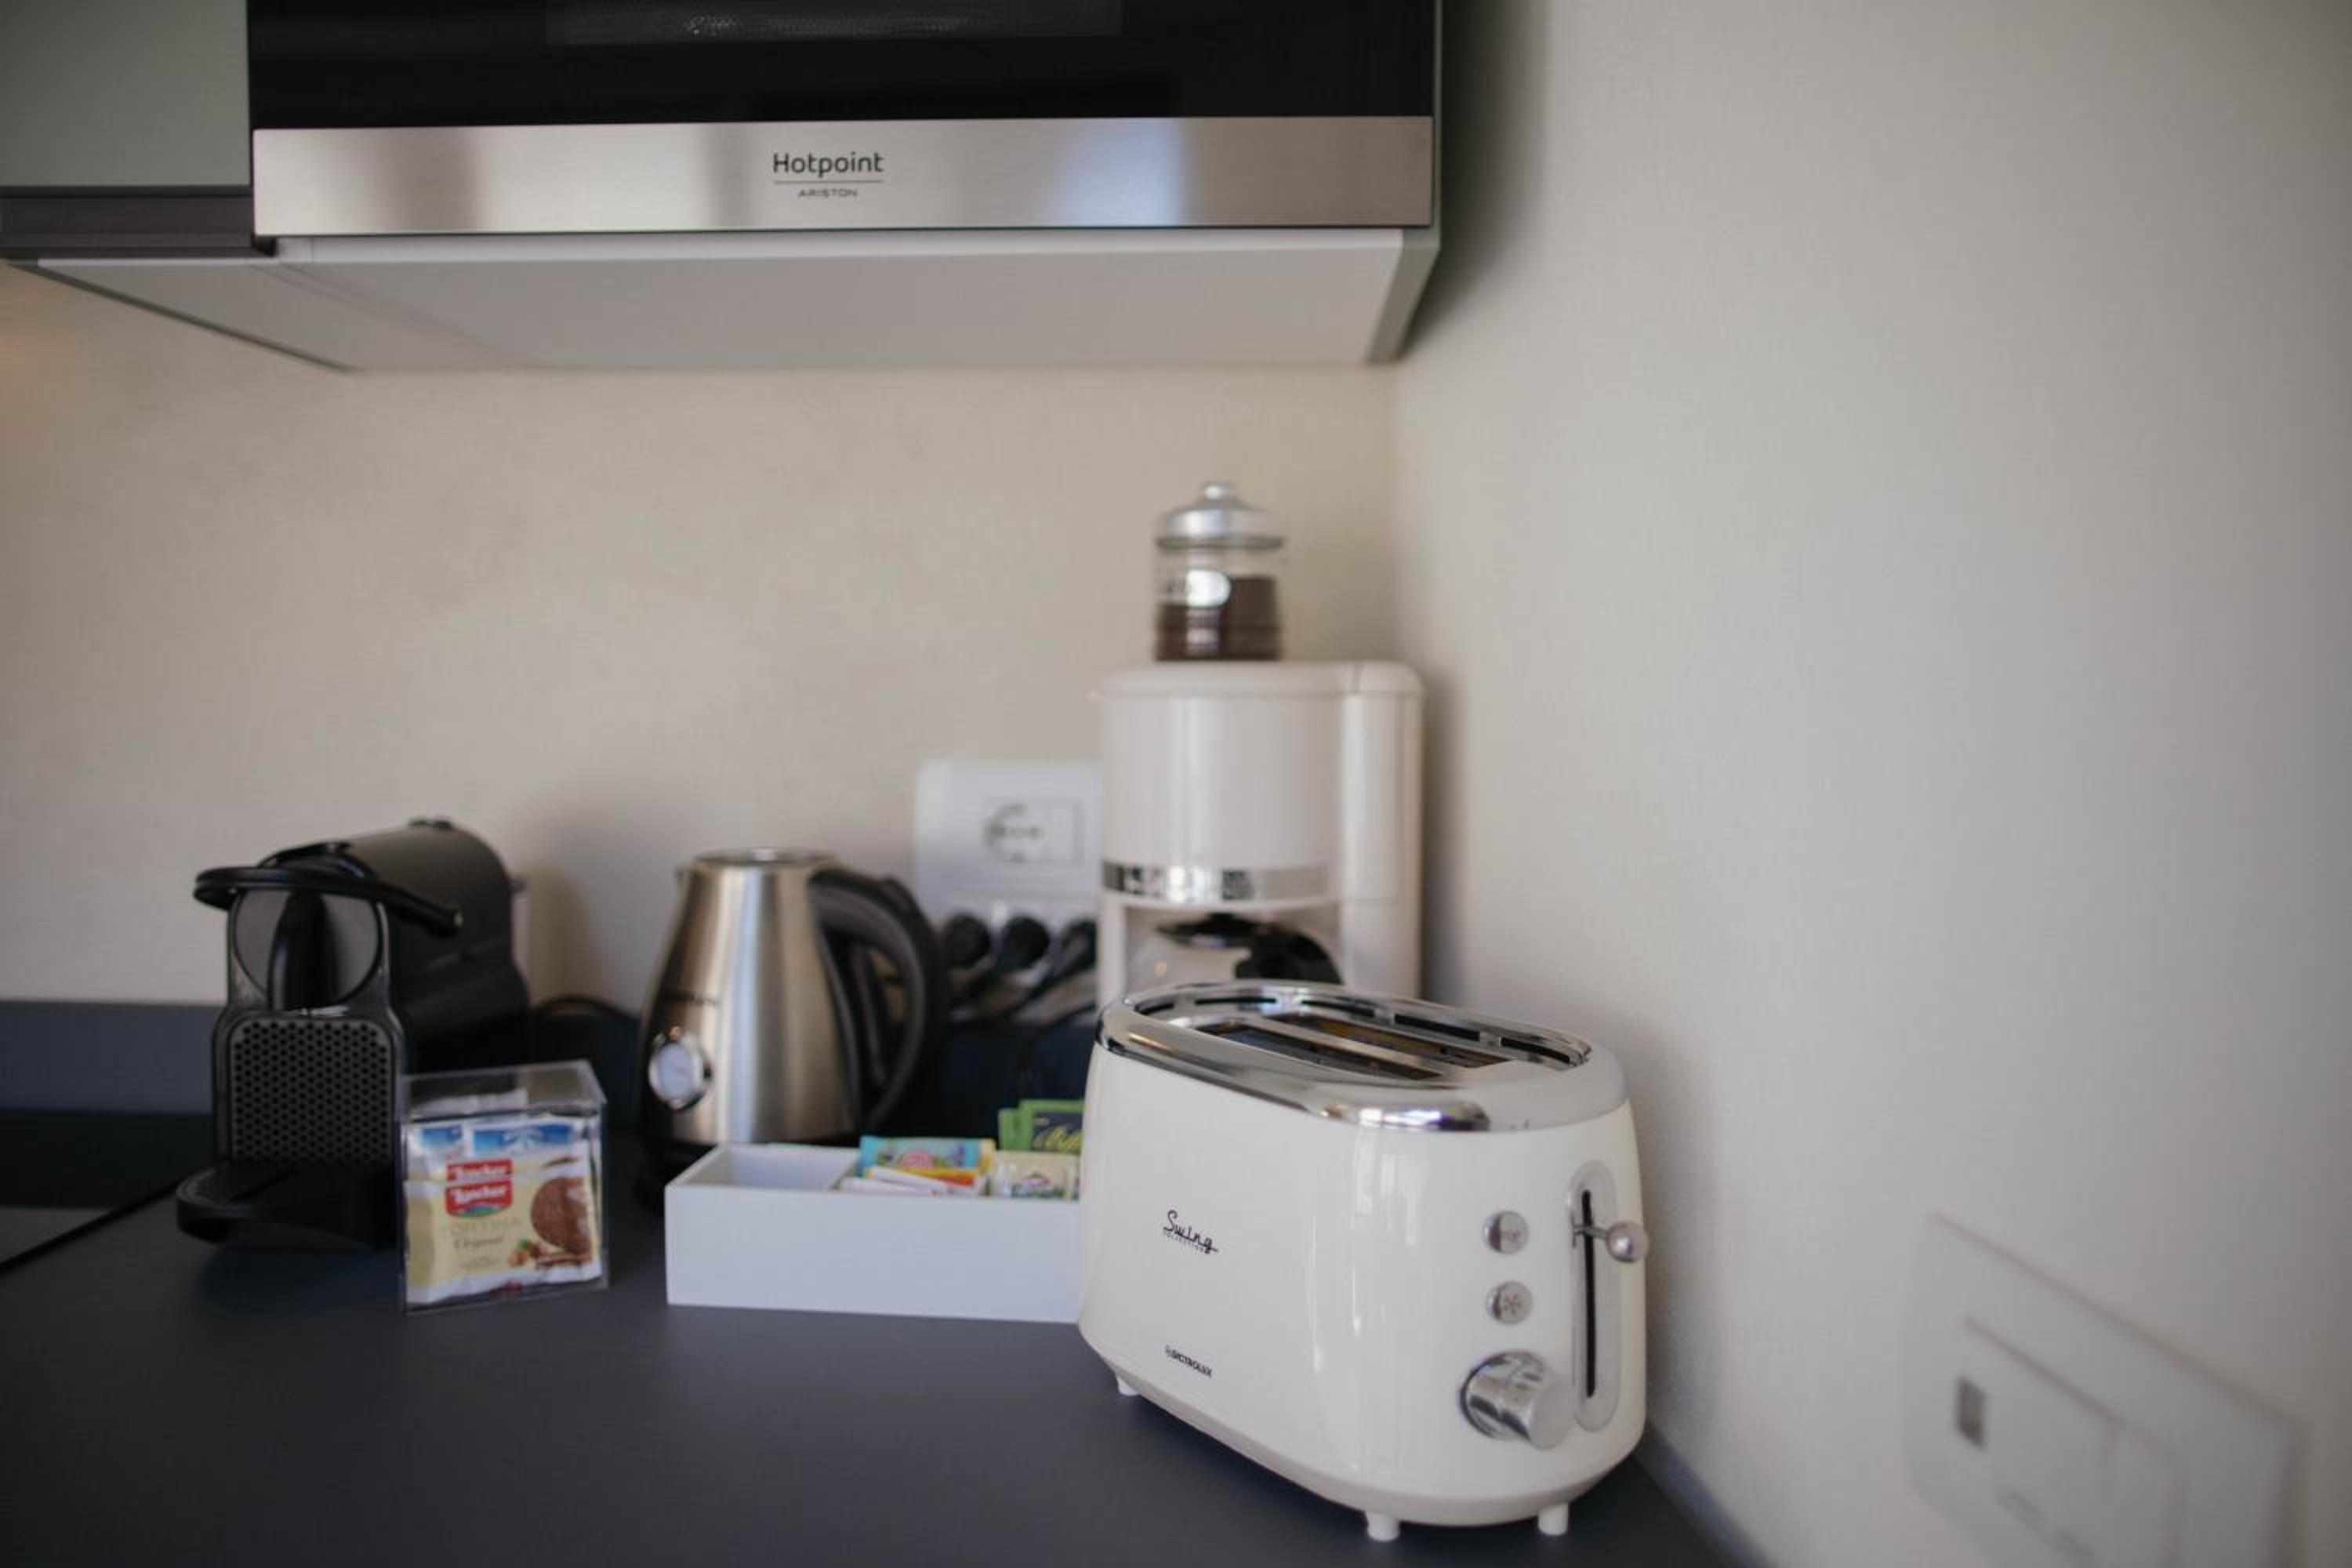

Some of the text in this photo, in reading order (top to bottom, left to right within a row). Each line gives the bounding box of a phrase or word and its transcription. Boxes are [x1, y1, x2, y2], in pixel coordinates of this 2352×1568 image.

[773, 151, 884, 177] Hotpoint
[798, 188, 858, 197] ARISTON
[1163, 1210, 1218, 1254] Swing
